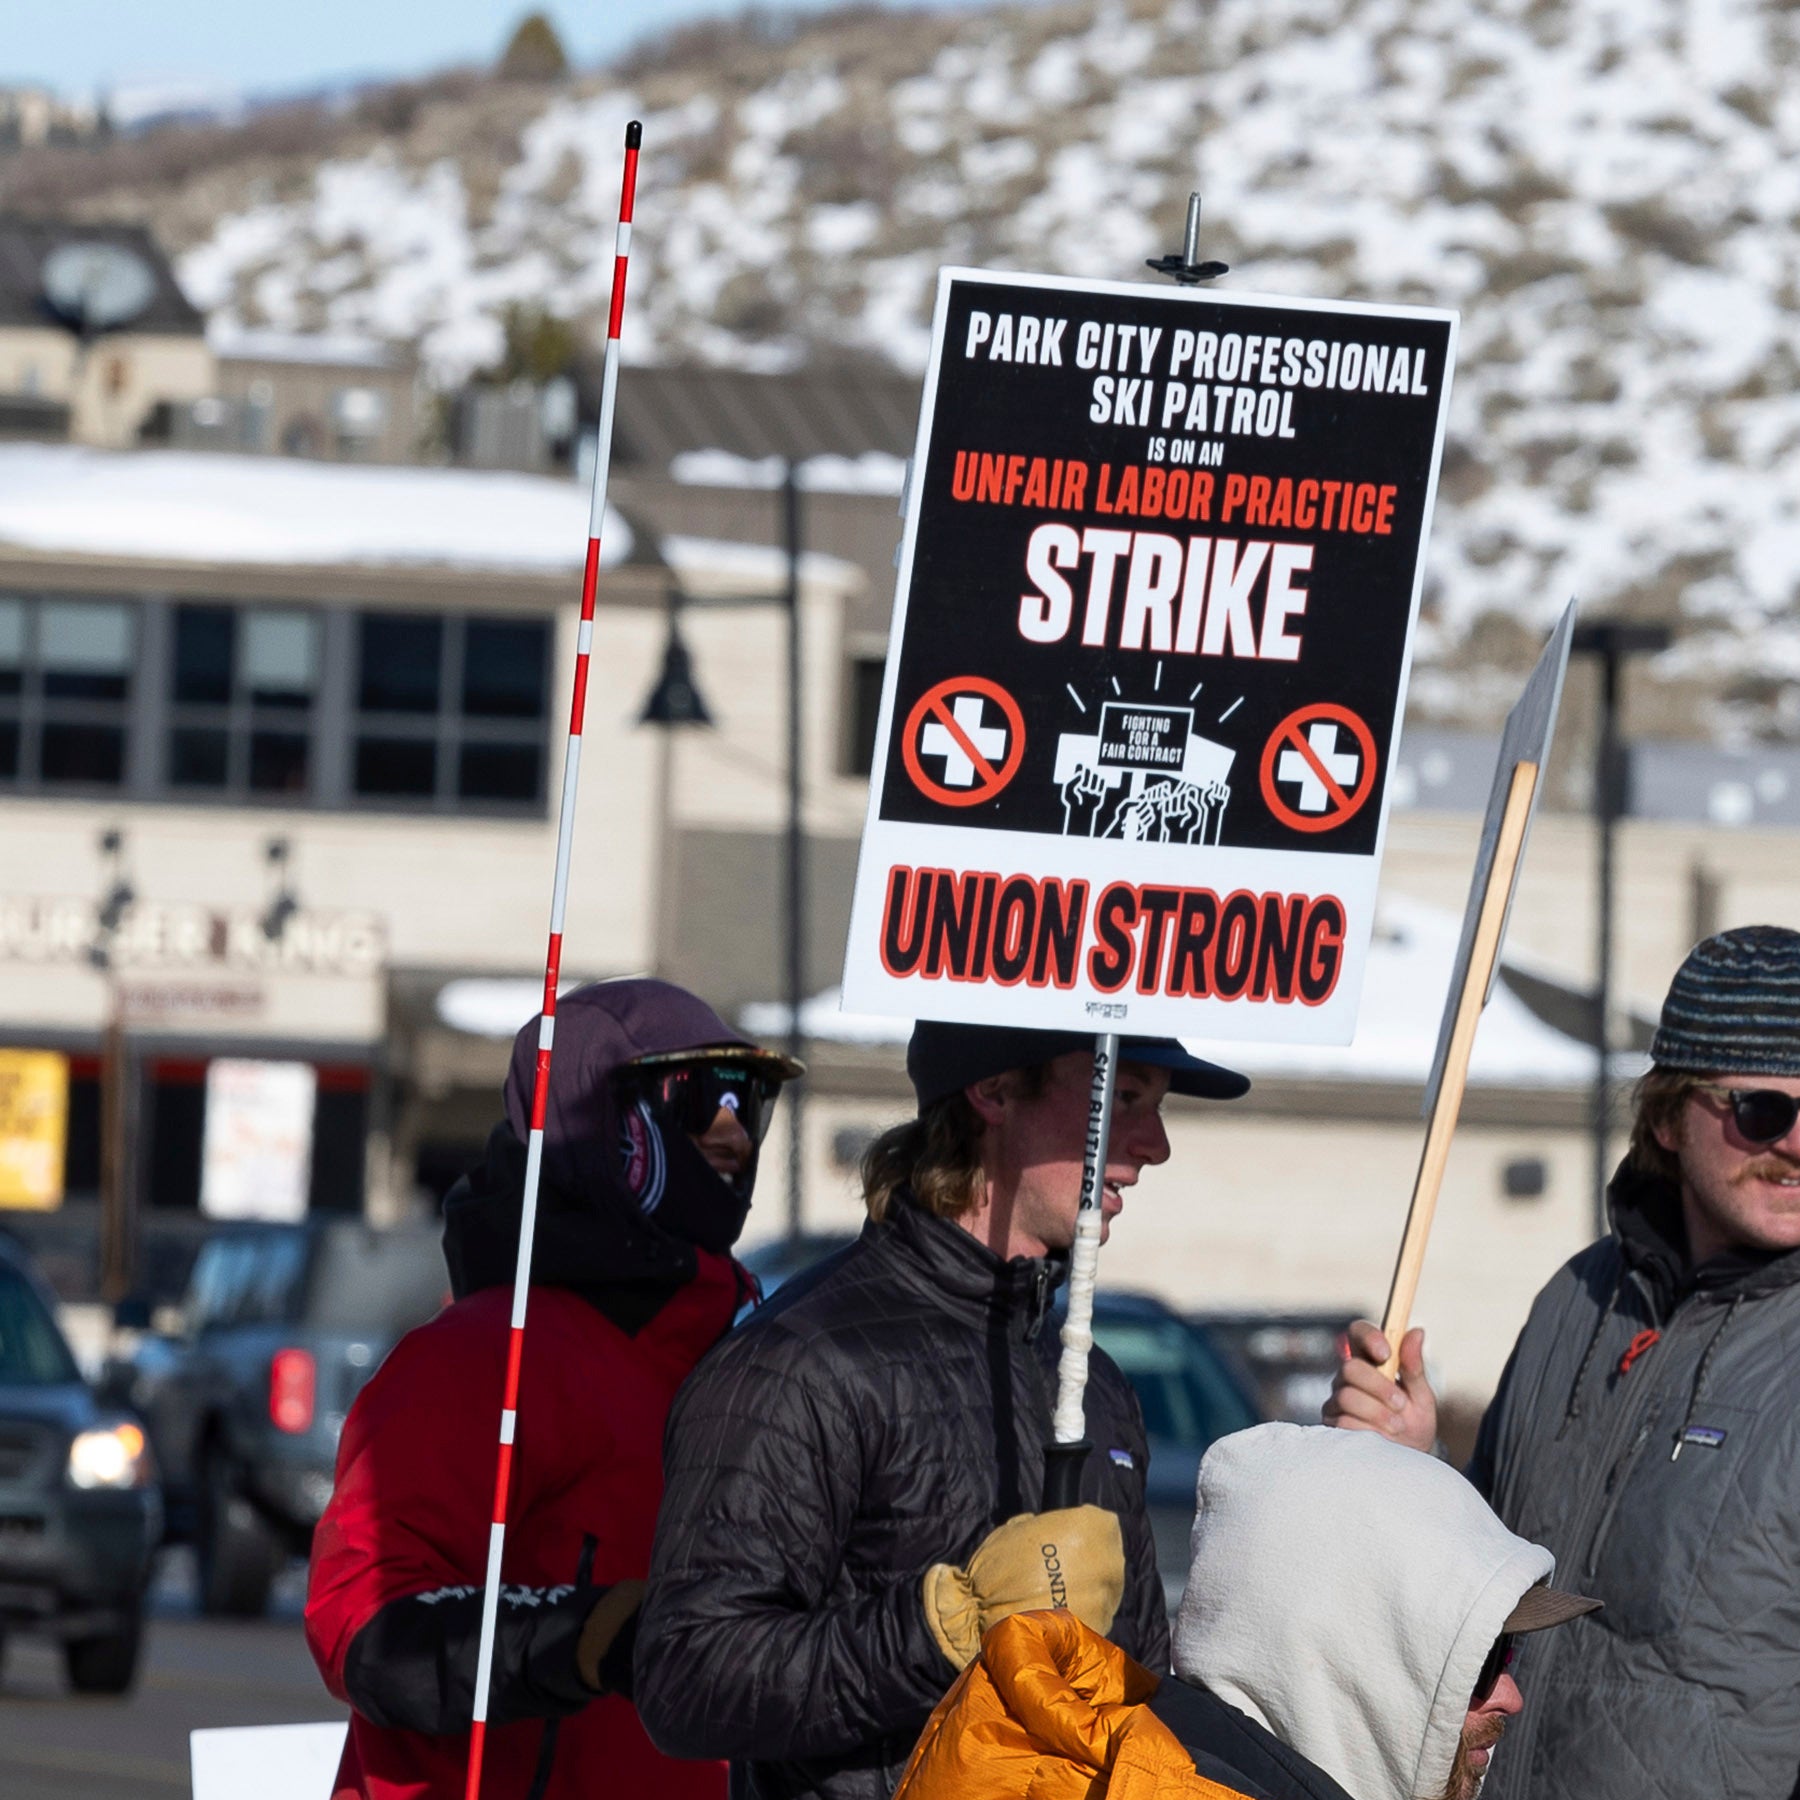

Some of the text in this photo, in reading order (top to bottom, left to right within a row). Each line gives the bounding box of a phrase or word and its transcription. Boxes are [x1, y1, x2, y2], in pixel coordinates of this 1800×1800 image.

[964, 310, 1428, 396] PARK CITY PROFESSIONAL
[1089, 375, 1297, 439] SKI PATROL
[1147, 436, 1225, 467] IS ON AN
[951, 449, 1398, 535] UNFAIR LABOR PRACTICE
[1017, 522, 1315, 661] STRIKE
[1101, 742, 1183, 763] FAIR CONTRACT
[1122, 714, 1171, 733] FIGHTING
[1128, 730, 1159, 747] FOR A
[879, 864, 1347, 1007] UNION STRONG
[1092, 1052, 1109, 1091] SKI
[1041, 1544, 1068, 1609] KINCO
